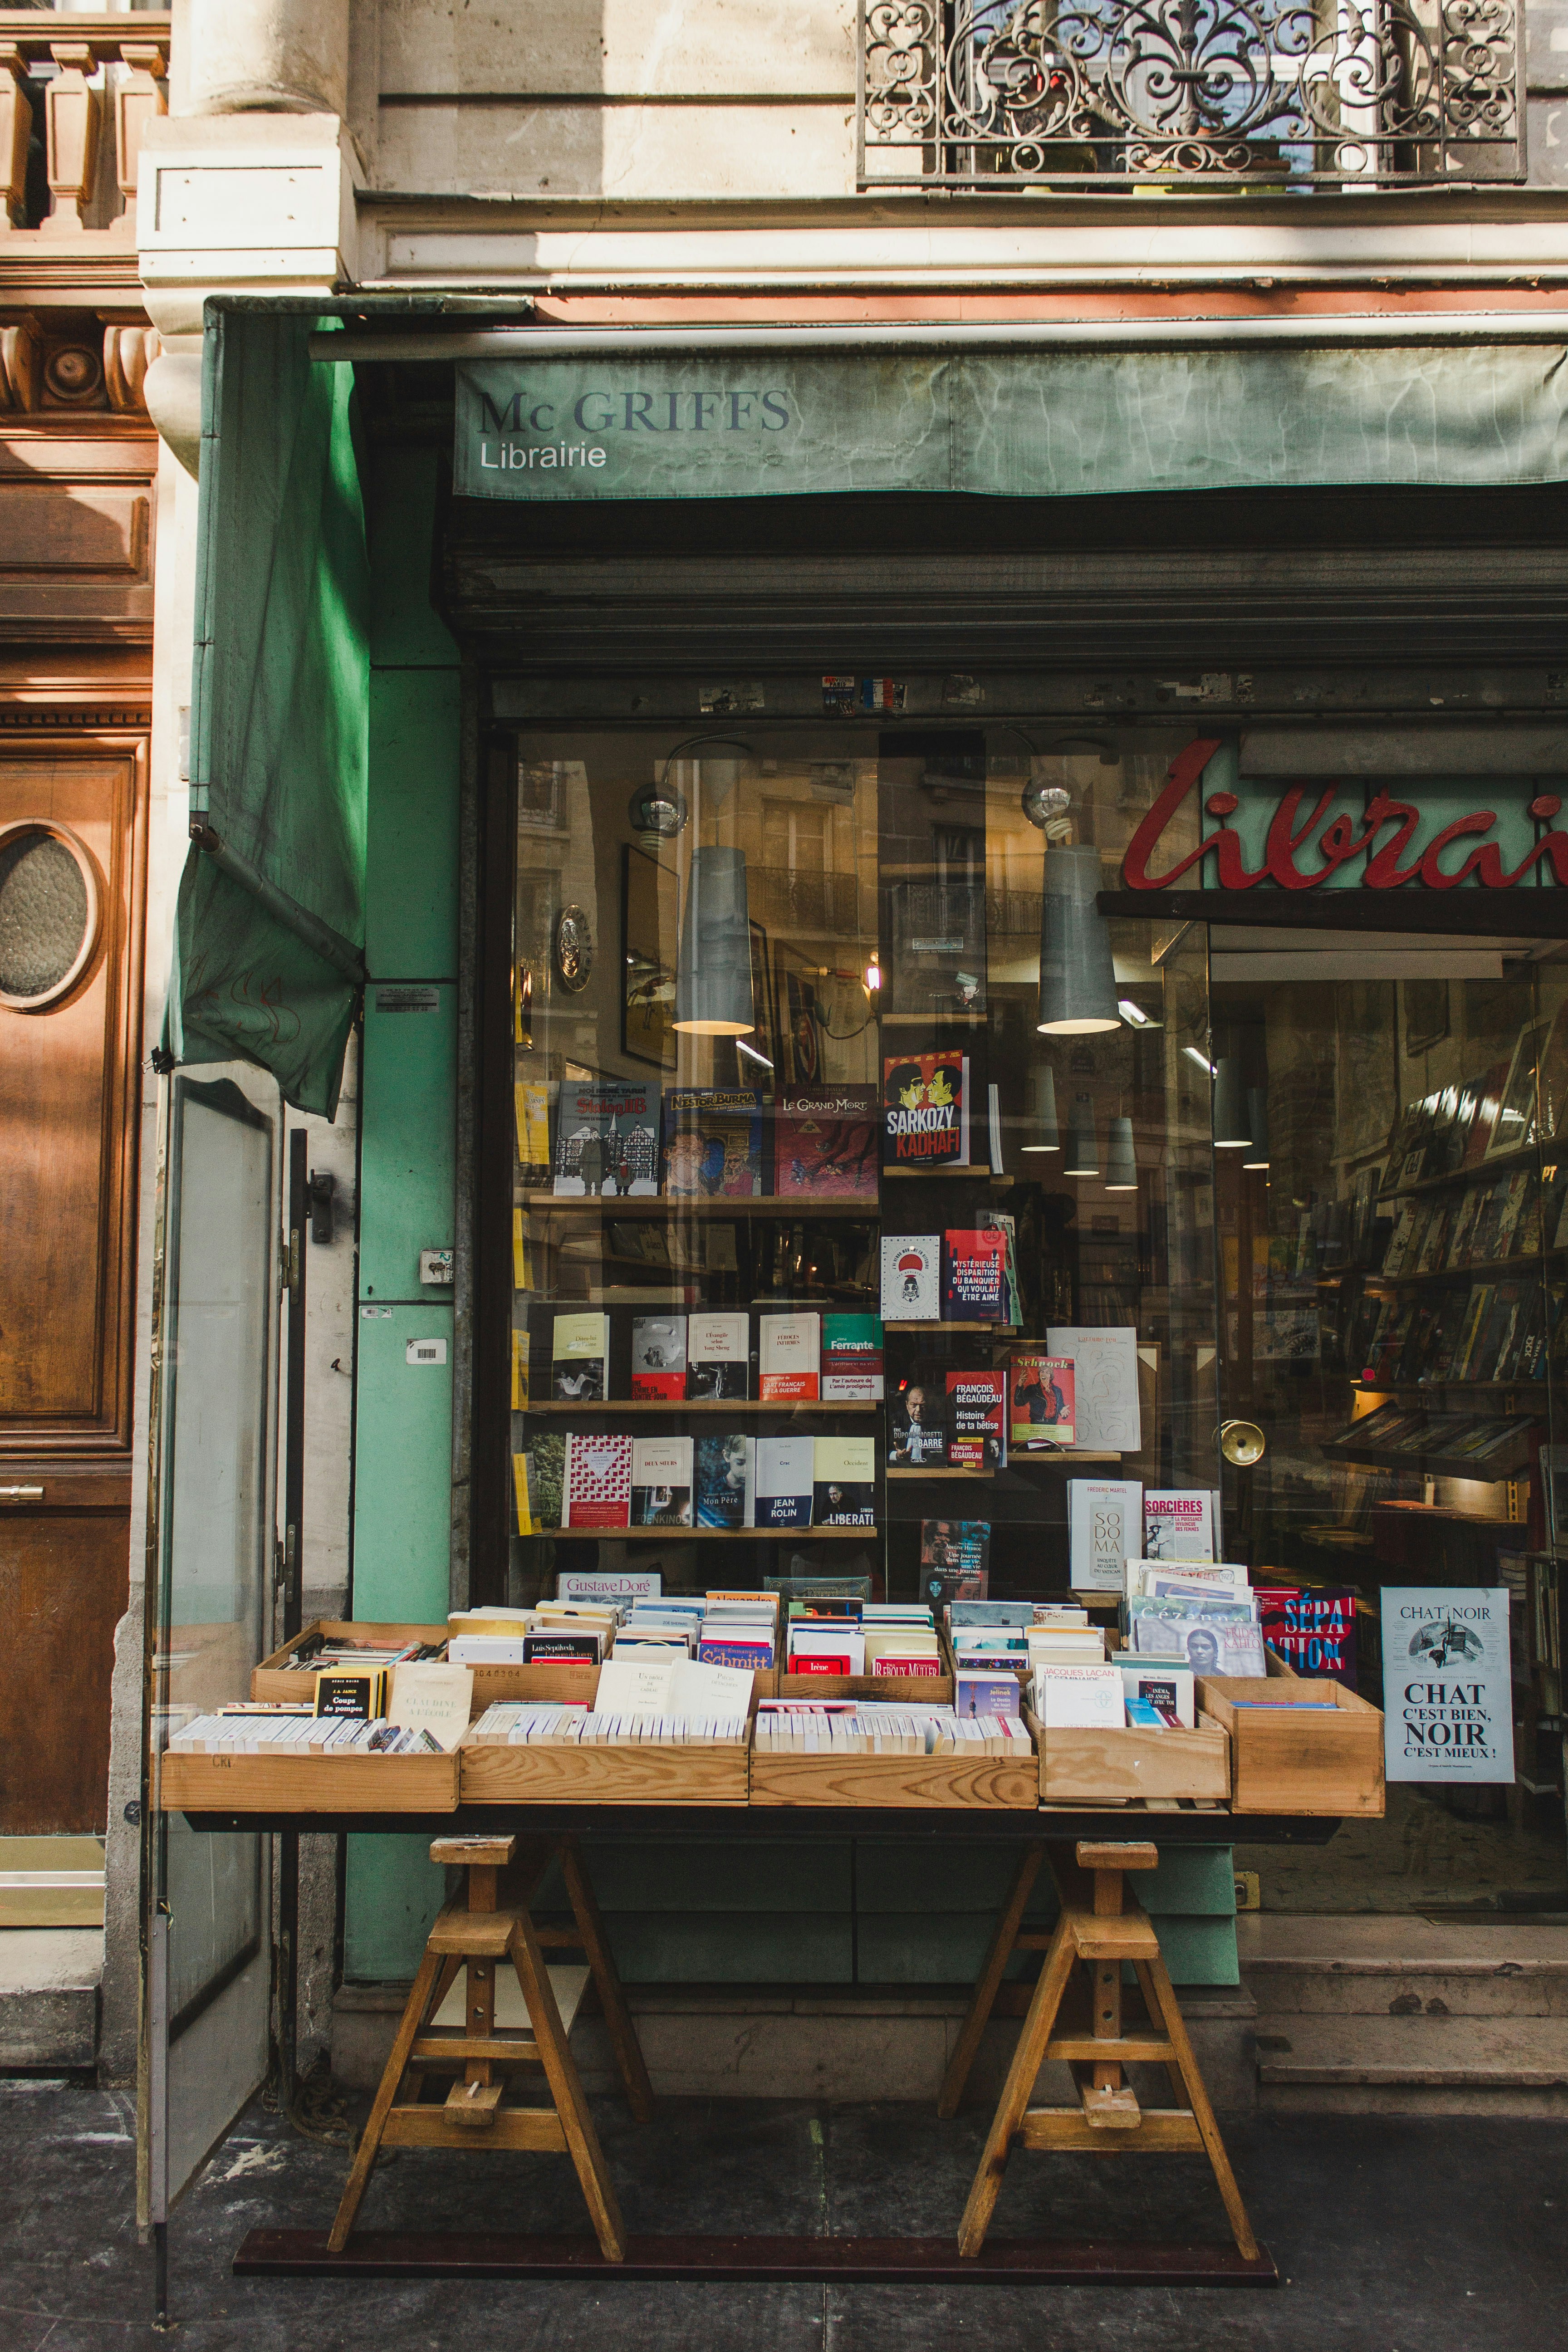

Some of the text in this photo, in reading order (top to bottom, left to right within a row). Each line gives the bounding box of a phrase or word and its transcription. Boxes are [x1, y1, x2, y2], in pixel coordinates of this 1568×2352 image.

[477, 390, 790, 434] Mc GRIFFS
[481, 441, 607, 469] Librairie
[577, 1097, 624, 1117] Stalag
[671, 1092, 757, 1111] NESTOR BURMA
[887, 1105, 954, 1134] SARKOZY
[897, 1129, 960, 1157] KADHAFI
[953, 1259, 1000, 1268] MYSTÉRIEUSE
[957, 1285, 969, 1294] QUI
[831, 1341, 874, 1350] Ferrante
[1017, 1358, 1068, 1369] Schnock
[956, 1384, 994, 1395] FRANÇOIS
[956, 1394, 1002, 1403] BÉGAUDEAU
[956, 1411, 985, 1420] Histoire
[956, 1421, 965, 1429] de
[977, 1421, 999, 1430] bêtise
[919, 1439, 943, 1447] BARRE
[951, 1451, 982, 1459] BÉGAUDEAU
[774, 1499, 795, 1507] JEAN
[1146, 1498, 1203, 1513] SORCIÈRES
[771, 1509, 797, 1518] ROLIN
[1095, 1512, 1120, 1526] SO
[636, 1514, 687, 1525] FOENKINOS
[829, 1514, 874, 1525] LIBERATI
[1094, 1526, 1120, 1539] DO
[1094, 1540, 1120, 1553] MA
[567, 1578, 651, 1592] Gustave Doré
[1284, 1592, 1345, 1633] SÉPA
[1400, 1606, 1491, 1620] CHAT NOIR
[1225, 1627, 1256, 1638] FRIDA
[545, 1643, 574, 1653] Sepúlveda
[1224, 1638, 1260, 1649] KAHLO
[702, 1651, 768, 1670] Schmitt
[810, 1662, 829, 1671] Irène
[908, 1663, 937, 1676] MULLER
[1044, 1668, 1083, 1676] JACQUES
[1404, 1683, 1486, 1705] CHAT
[406, 1698, 456, 1709] CLAUDINE
[416, 1708, 452, 1718] L'ÉCOLE
[1402, 1708, 1492, 1723] C'EST BIEN,
[1403, 1722, 1488, 1746] NOIR
[1404, 1747, 1489, 1758] C'EST MIEUX
